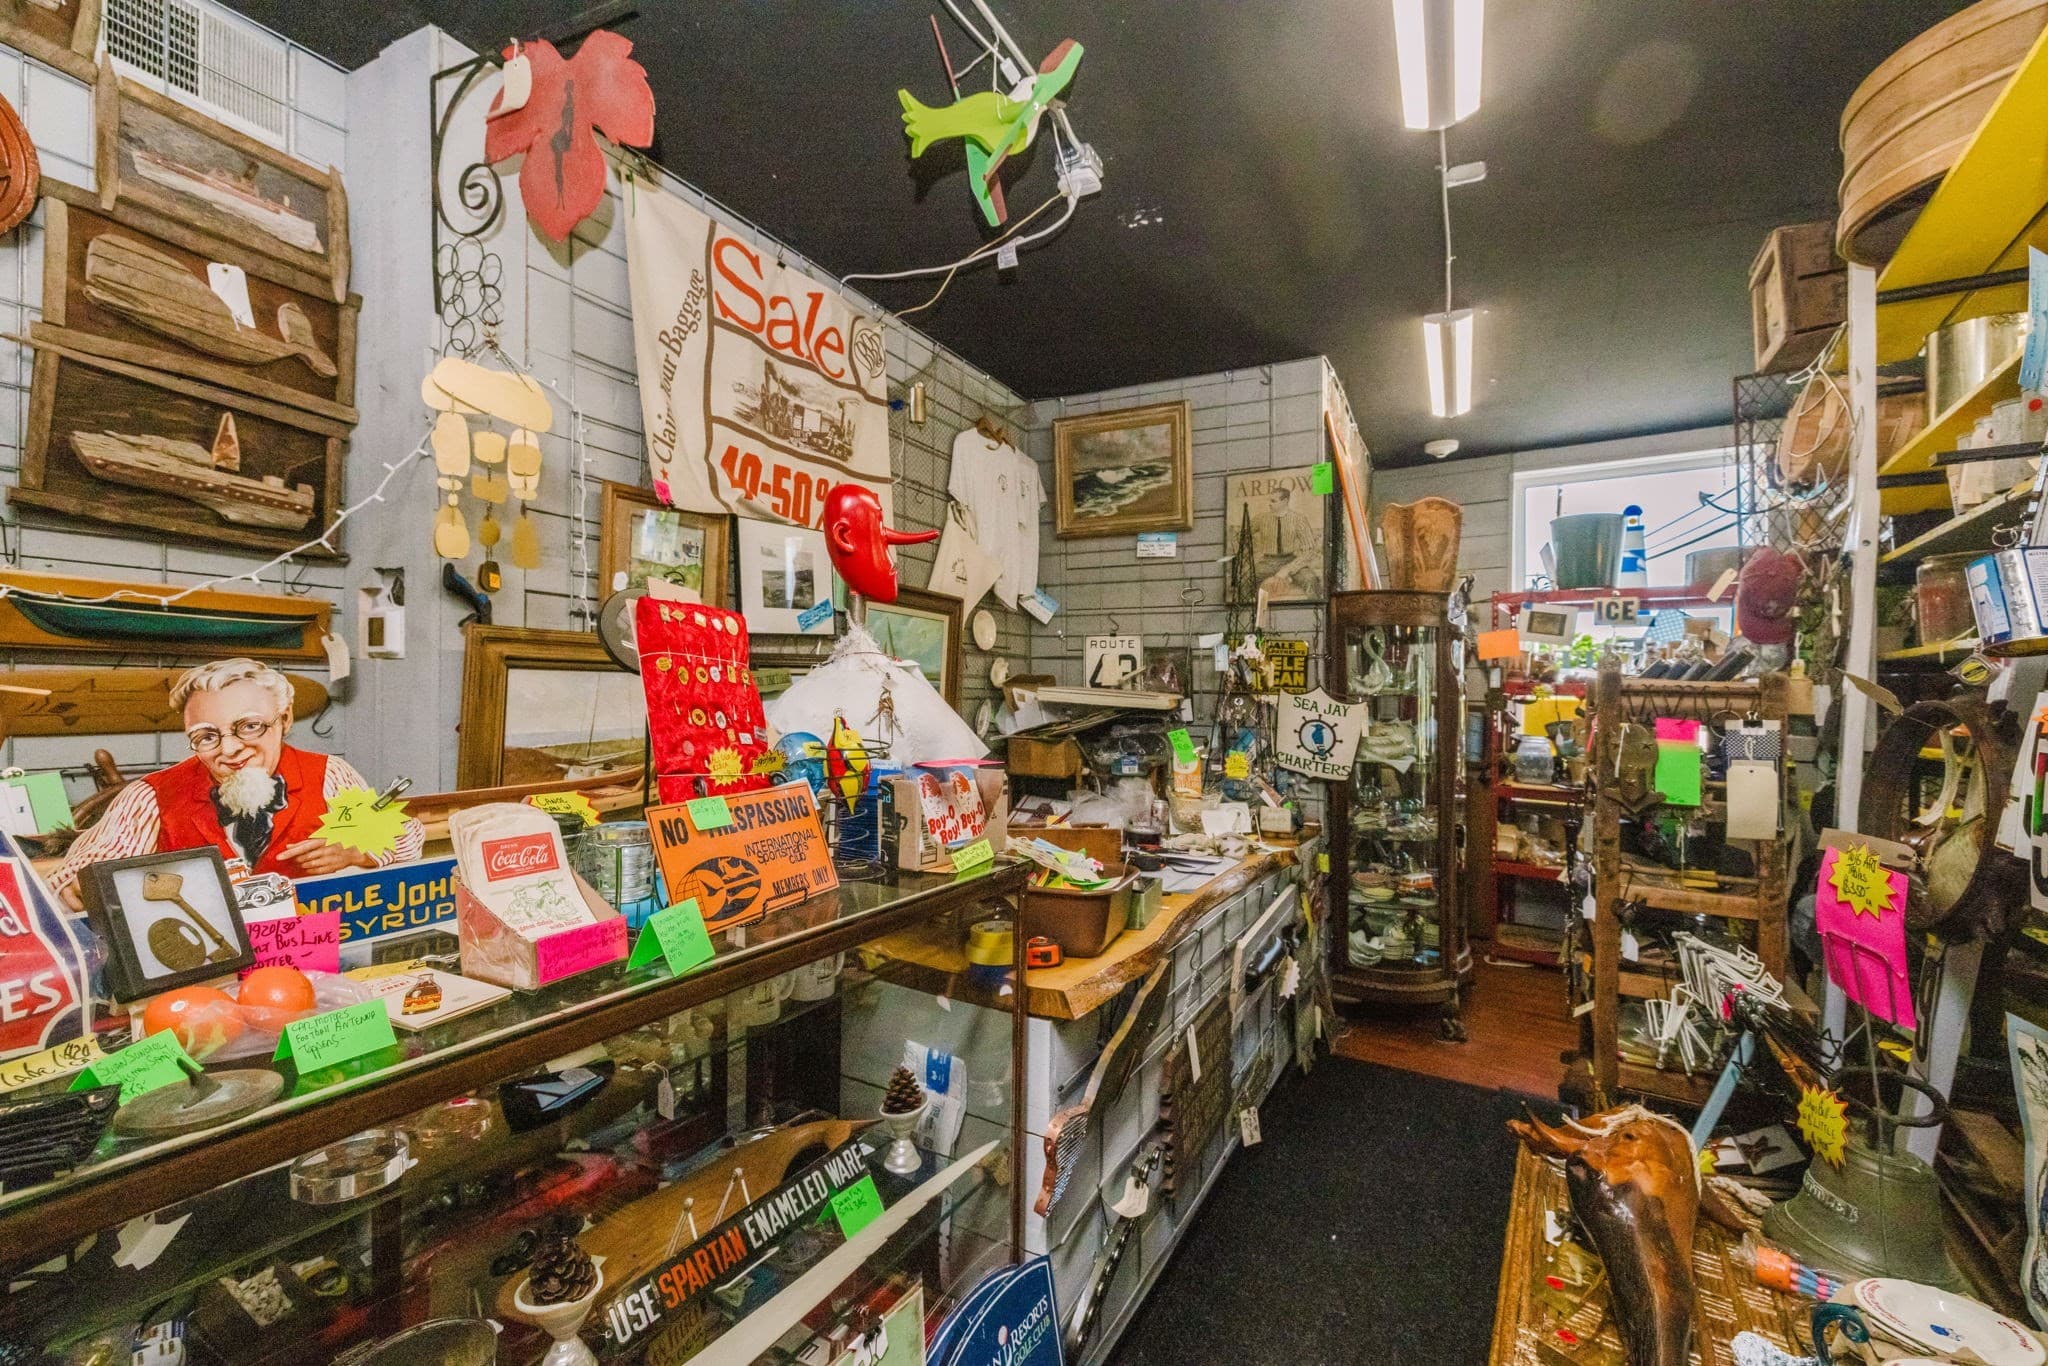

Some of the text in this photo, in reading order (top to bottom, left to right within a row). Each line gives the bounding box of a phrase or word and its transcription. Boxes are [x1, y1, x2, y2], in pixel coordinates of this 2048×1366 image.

[658, 268, 706, 358] Baggage
[713, 237, 845, 379] Sale
[1237, 472, 1313, 498] ARROW
[1598, 600, 1636, 621] ICE
[1090, 640, 1135, 649] ROUTE
[1293, 696, 1350, 718] SEA JAY
[1275, 750, 1351, 777] CHARTERS
[659, 816, 689, 848] NO
[928, 804, 955, 835] Boy-O
[744, 828, 818, 857] INTERNATIONAL
[491, 843, 549, 872] Coca-Cola
[772, 866, 829, 896] MEMBERS ONLY
[339, 902, 455, 940] SYRUP
[609, 1283, 662, 1345] USE
[658, 1225, 748, 1309] SPARTAN
[744, 1171, 830, 1250] ENAMELED
[825, 1143, 867, 1189] WARE
[1009, 1294, 1049, 1345] RESORTS
[1032, 1314, 1051, 1341] CLUB
